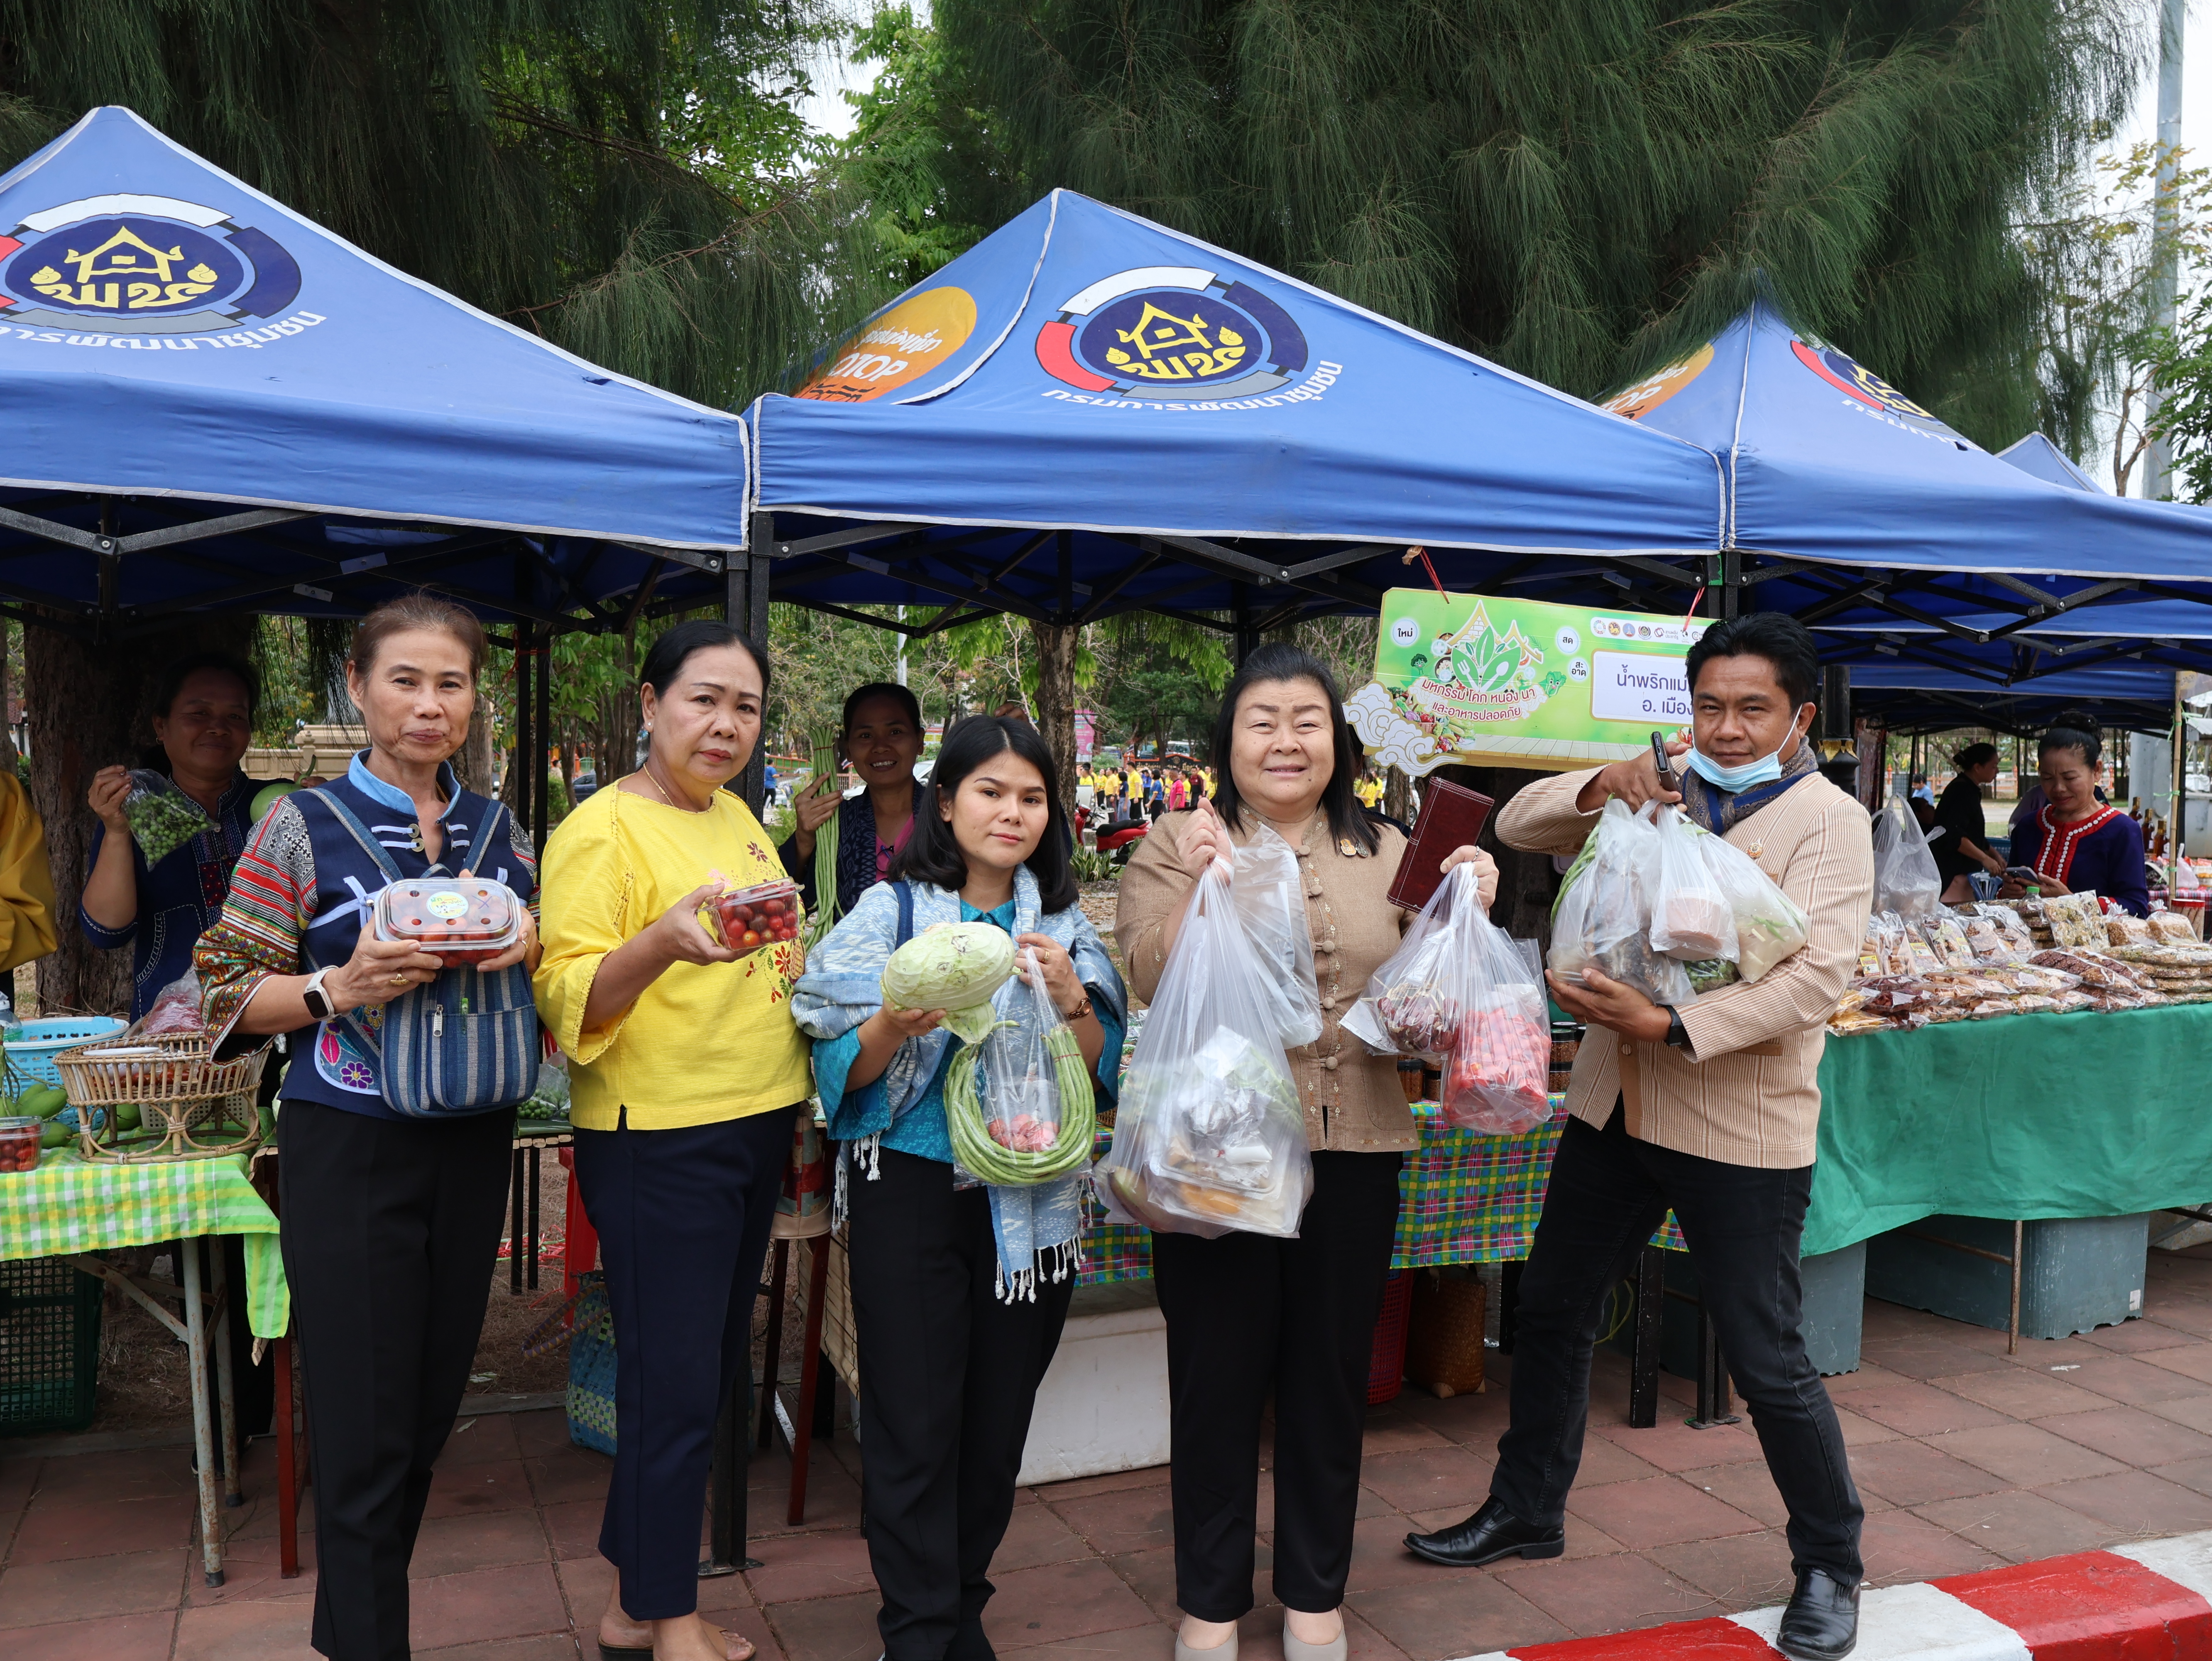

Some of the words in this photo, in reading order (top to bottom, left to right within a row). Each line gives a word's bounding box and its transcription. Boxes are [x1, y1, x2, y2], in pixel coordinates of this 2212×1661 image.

[829, 352, 908, 382] OTOP
[1041, 360, 1343, 411] กรมการพัฒนาชุมชน
[1397, 627, 1413, 638] ใหม่
[1562, 636, 1573, 644] สด
[1571, 668, 1587, 676] อาด
[1422, 679, 1466, 701] มหกรรม
[1468, 689, 1487, 703] โคก
[1490, 692, 1519, 703] หนอง
[1522, 688, 1536, 699] นา
[1432, 702, 1521, 720] และอาหารปลอดภัย
[1642, 699, 1656, 713] อ.
